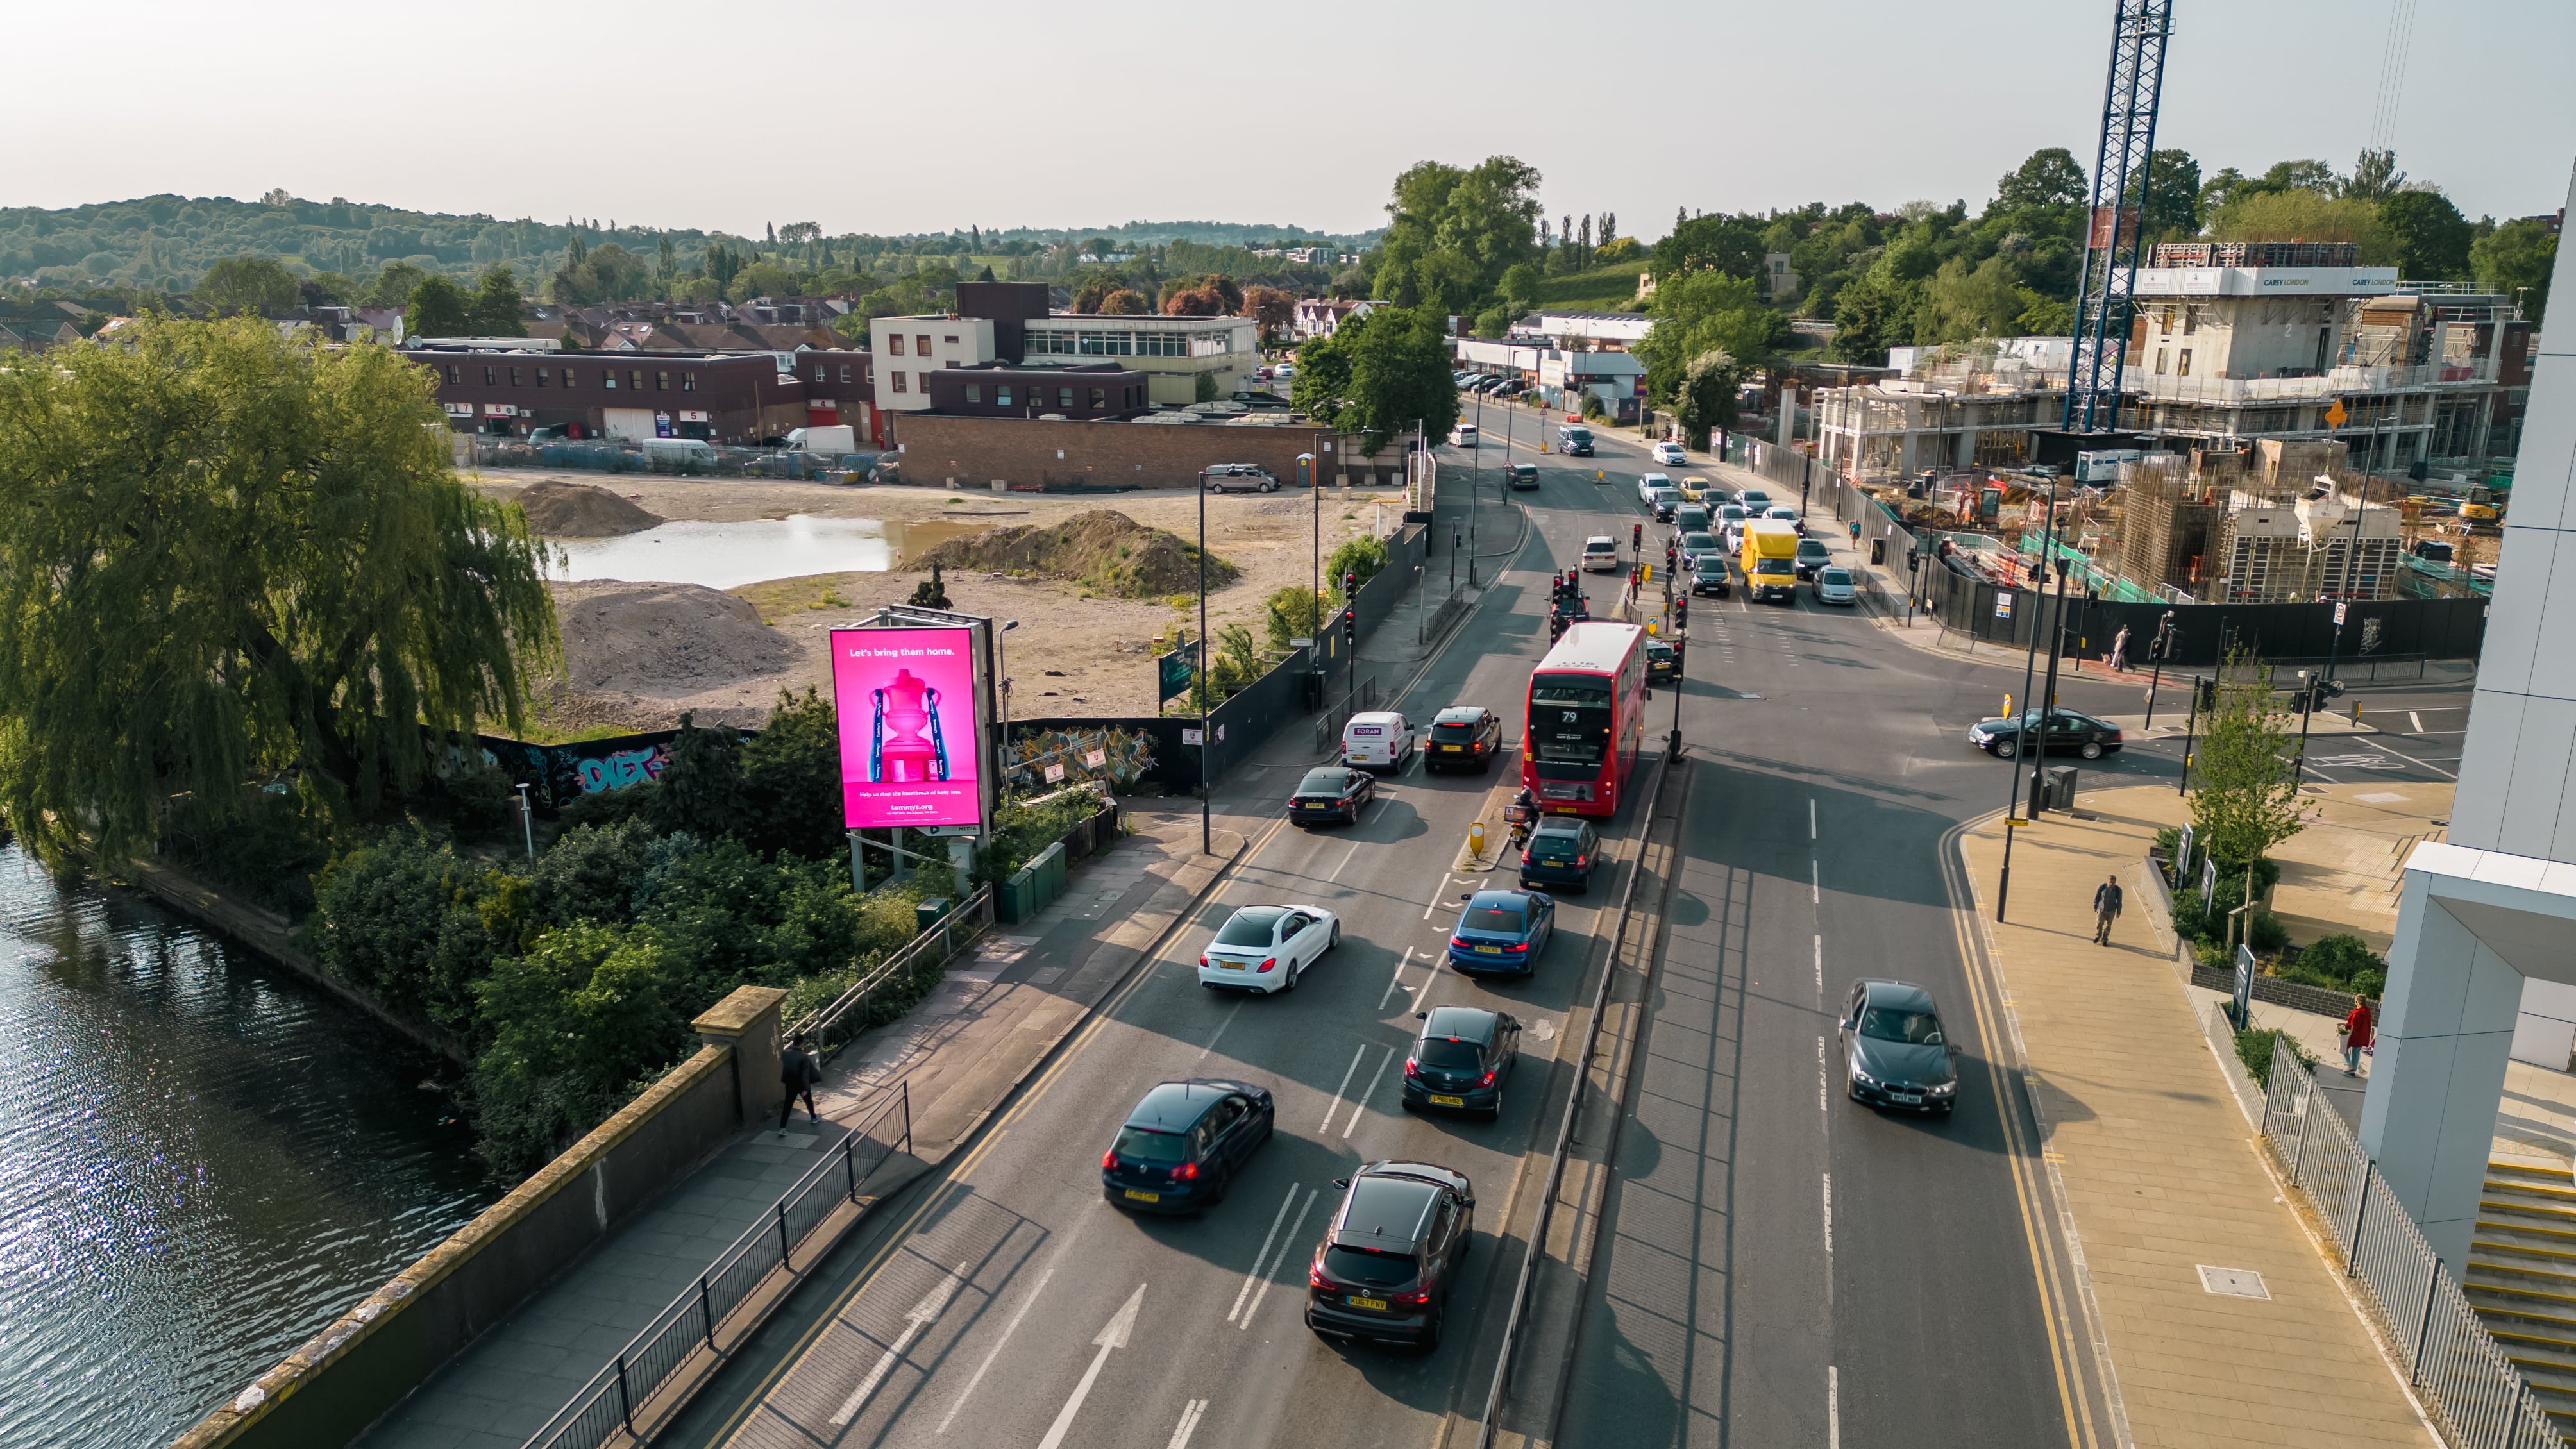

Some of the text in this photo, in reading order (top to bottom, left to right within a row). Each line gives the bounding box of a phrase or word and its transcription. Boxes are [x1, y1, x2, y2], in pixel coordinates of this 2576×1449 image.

[2264, 278, 2309, 287] CAREY LONDON
[2352, 278, 2395, 287] CAREY LONDON
[2284, 323, 2293, 337] 2
[691, 412, 696, 420] 5
[850, 647, 955, 658] Let's bring them home.
[1563, 711, 1577, 722] 79
[1351, 1296, 1385, 1309] KU67 FNV
